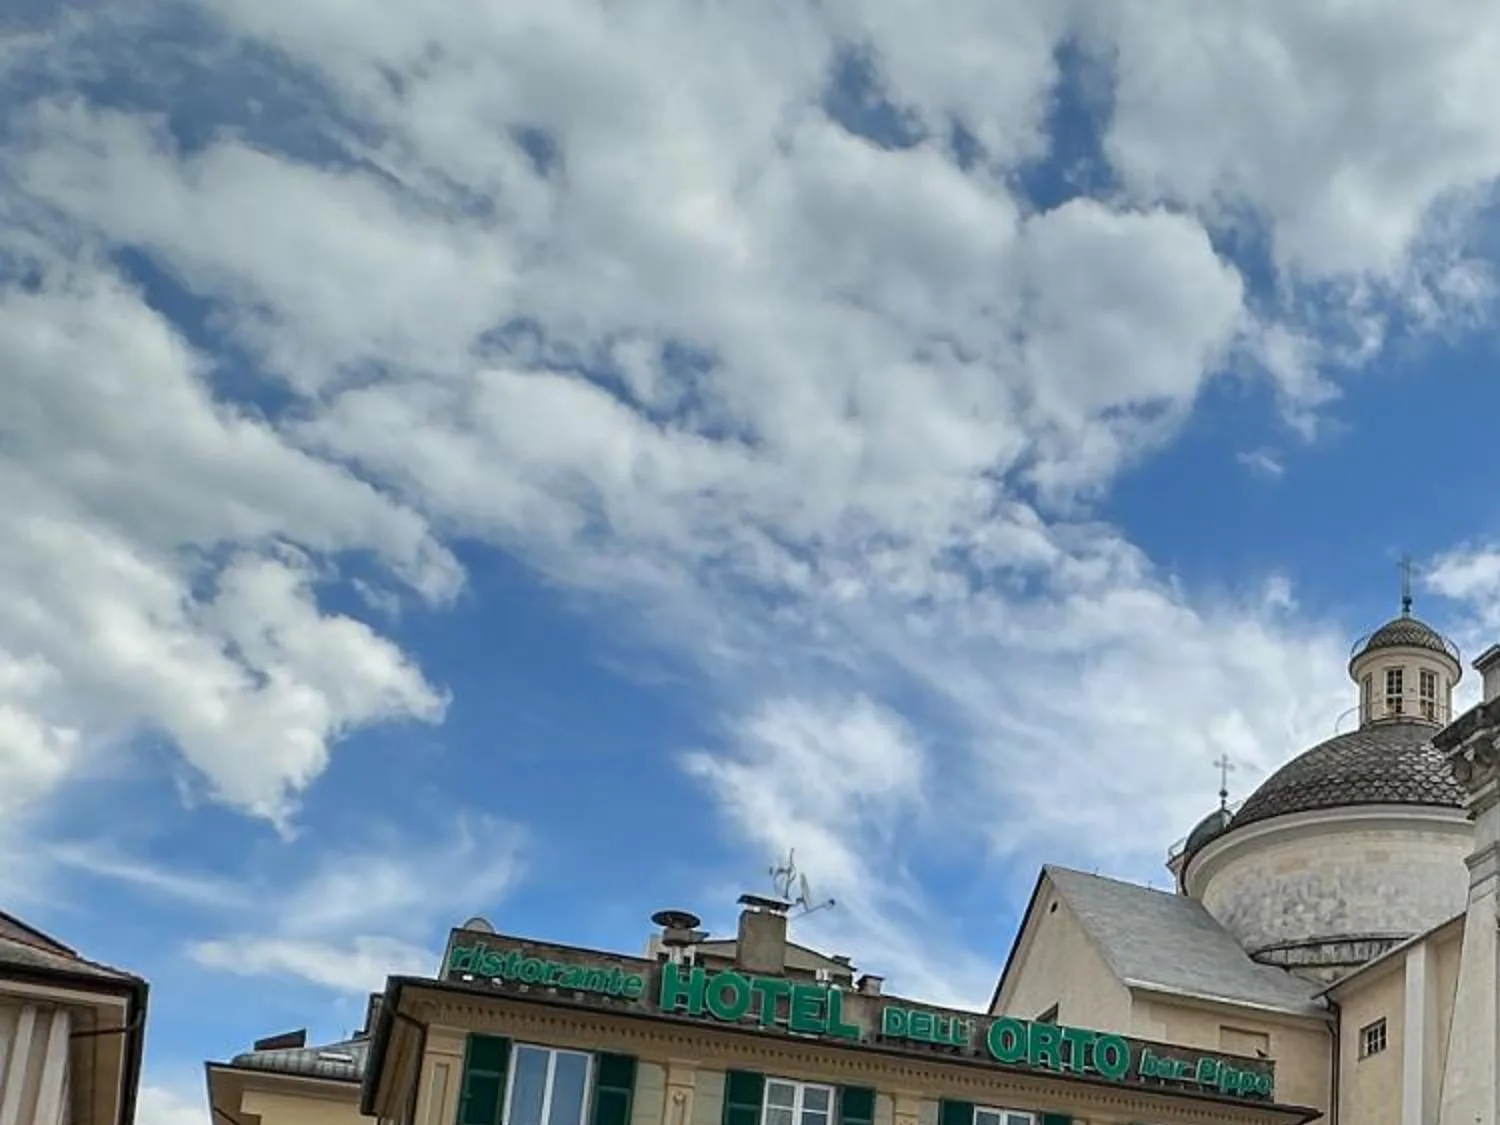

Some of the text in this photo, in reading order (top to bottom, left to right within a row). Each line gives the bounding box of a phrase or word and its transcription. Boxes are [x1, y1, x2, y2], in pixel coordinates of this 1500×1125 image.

[449, 942, 645, 998] ristorante
[659, 961, 860, 1038] HOTEL
[988, 1016, 1130, 1080] ORTO
[1139, 1047, 1194, 1079] bar
[1196, 1056, 1273, 1096] Pippo
